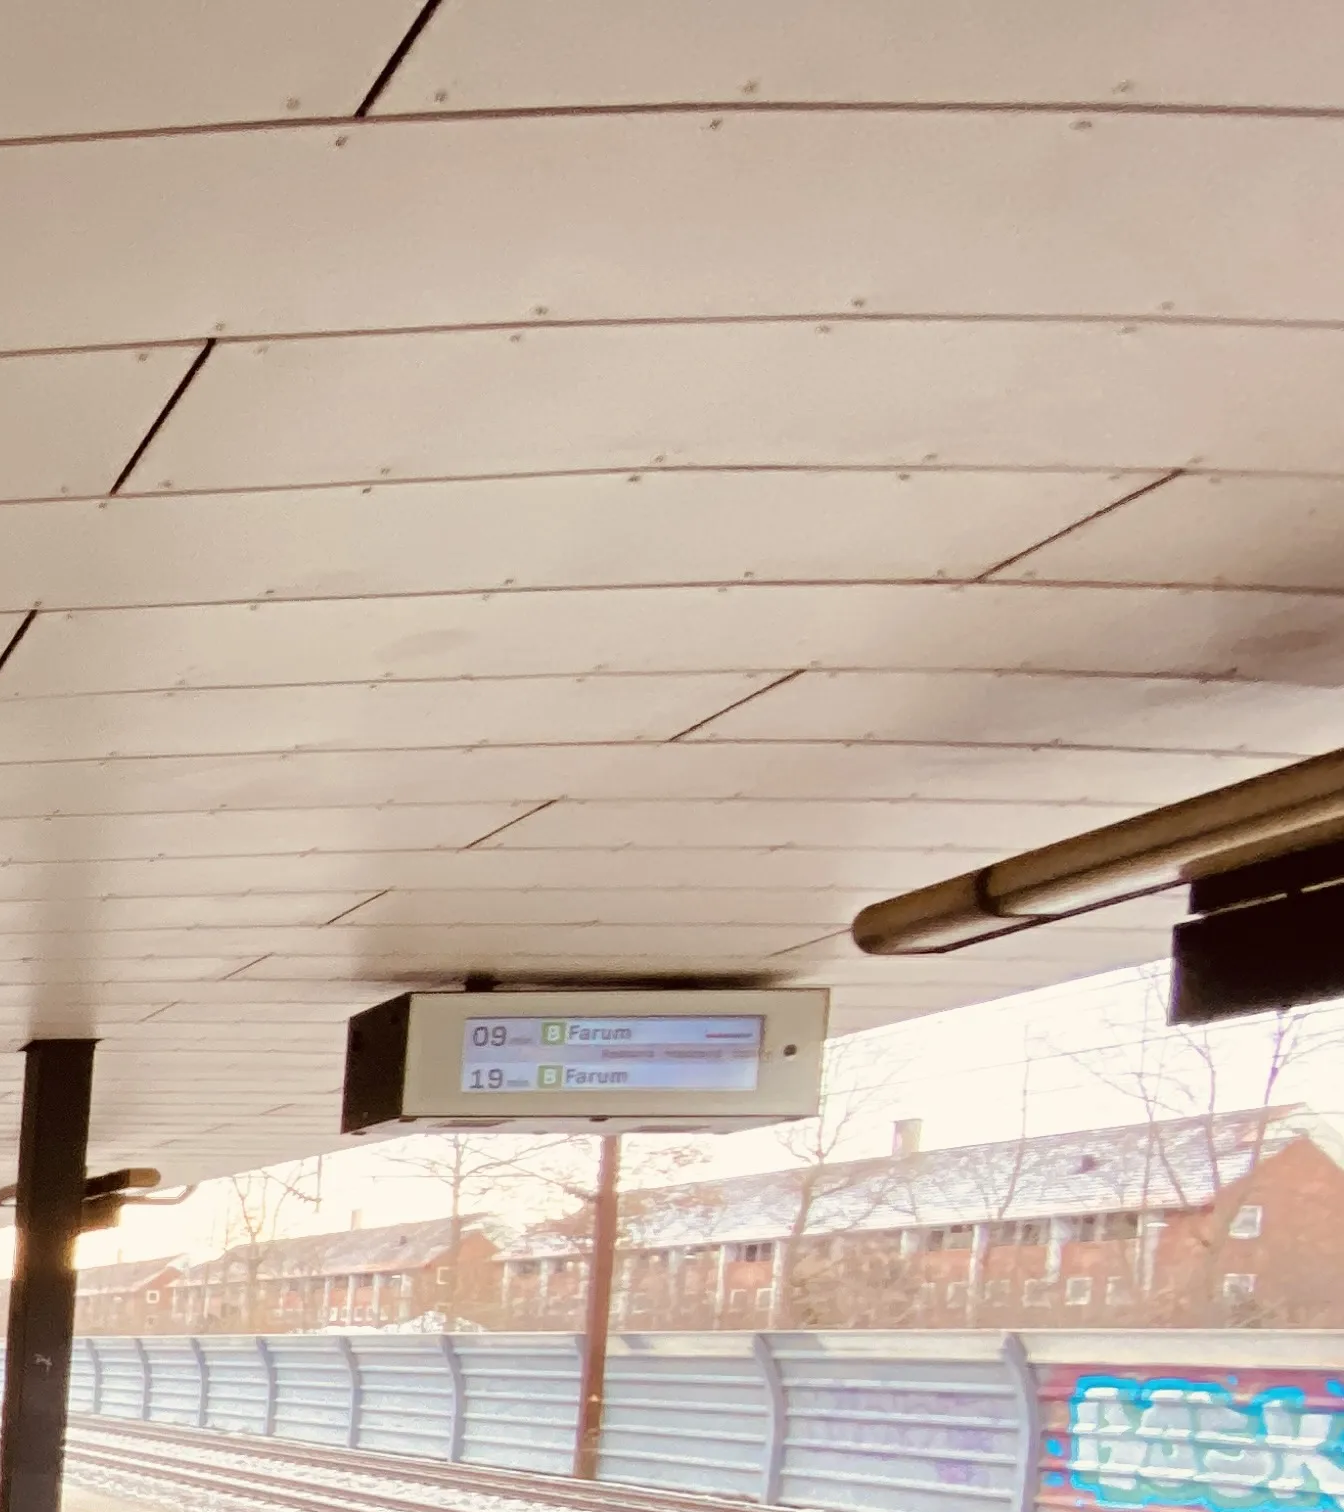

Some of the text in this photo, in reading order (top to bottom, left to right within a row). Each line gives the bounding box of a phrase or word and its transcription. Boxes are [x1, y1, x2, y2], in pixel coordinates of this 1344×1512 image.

[472, 1025, 507, 1047] 09
[568, 1024, 633, 1042] Farum
[469, 1068, 504, 1089] 19
[565, 1067, 629, 1085] Farum
